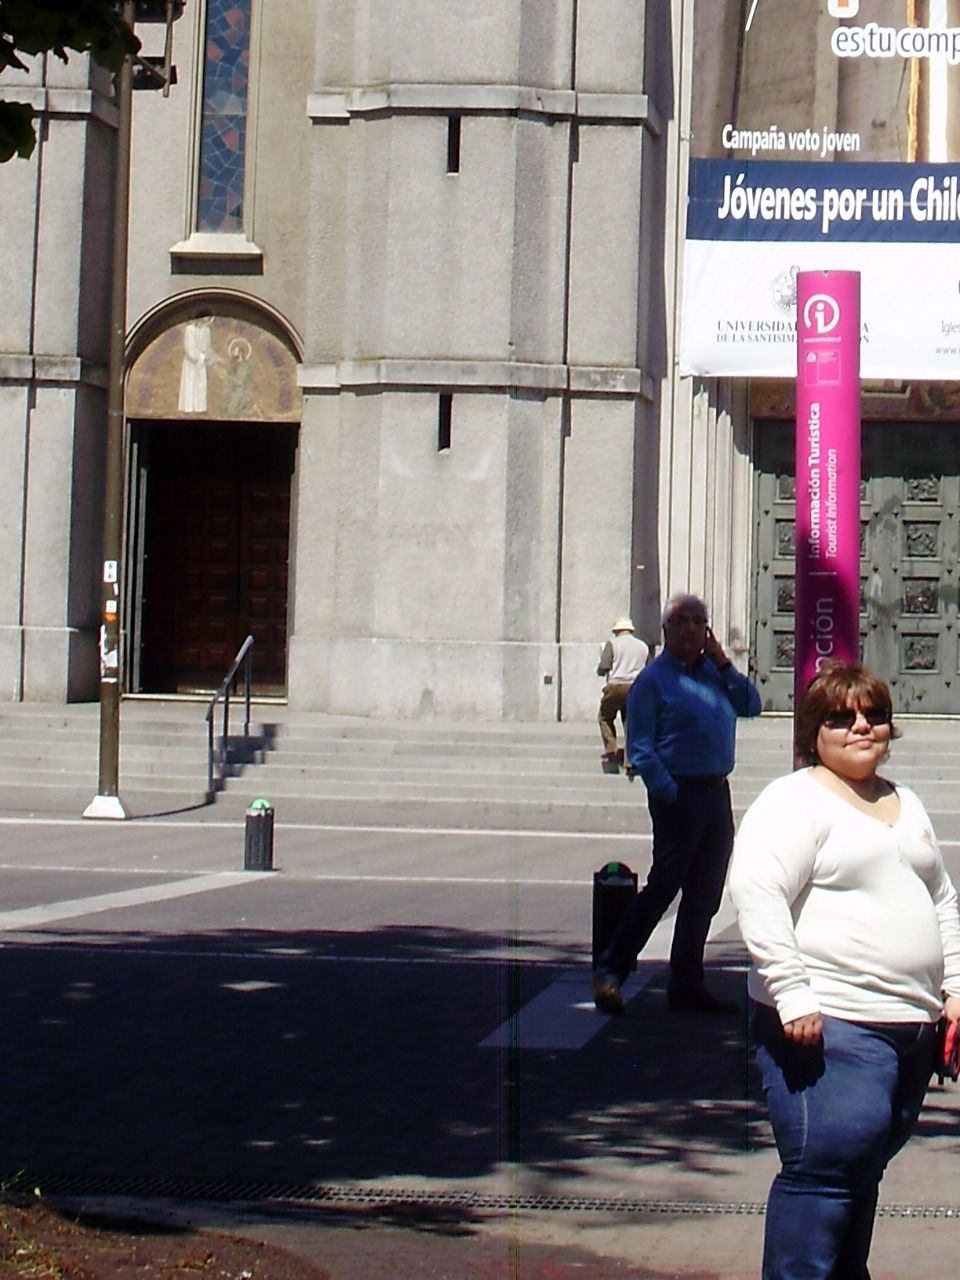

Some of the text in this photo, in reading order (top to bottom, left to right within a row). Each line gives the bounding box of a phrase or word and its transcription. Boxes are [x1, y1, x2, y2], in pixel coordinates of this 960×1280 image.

[836, 30, 860, 52] es
[868, 27, 891, 52] tu
[722, 123, 860, 158] Campaña voto joven
[717, 173, 818, 221] Jóvenes
[822, 188, 868, 233] por
[872, 190, 903, 221] un
[716, 333, 728, 344] DE
[732, 333, 745, 344] LA
[747, 333, 797, 344] SANTISIM
[808, 402, 820, 559] Información Turística
[825, 448, 837, 559] Tourist Information
